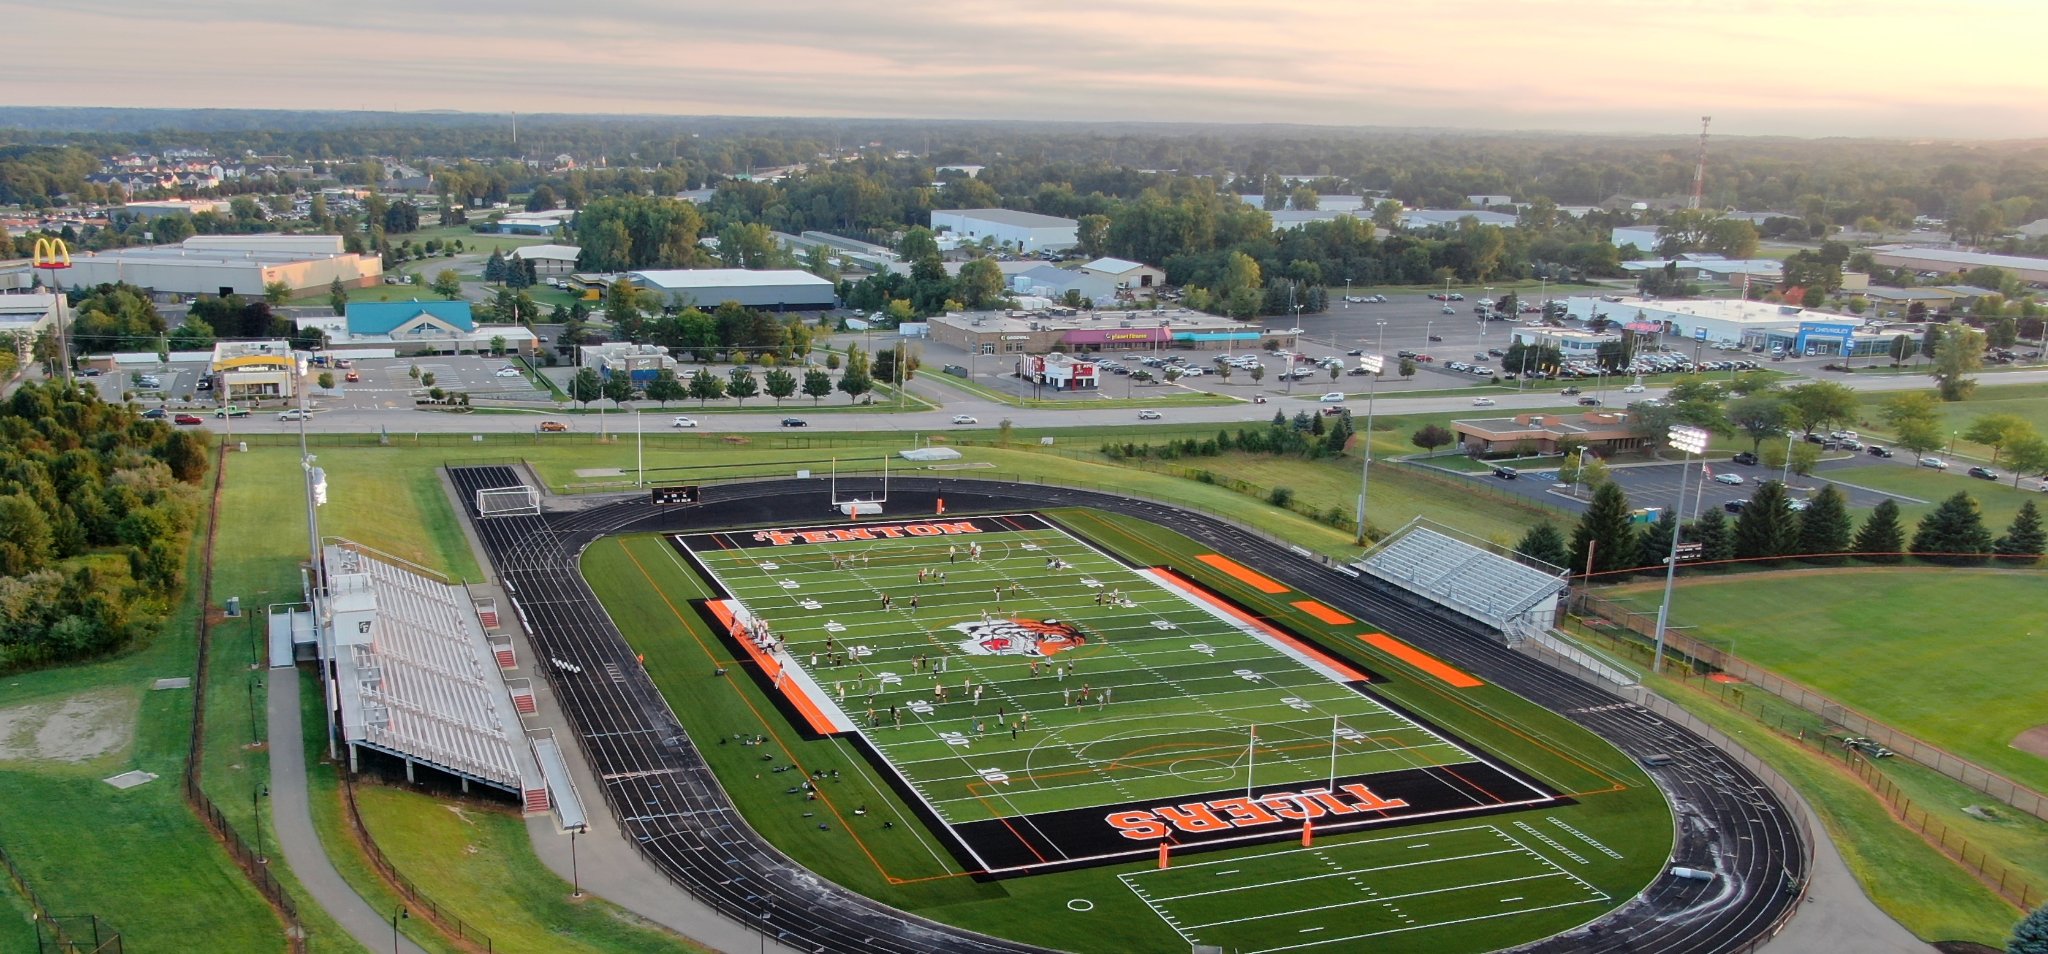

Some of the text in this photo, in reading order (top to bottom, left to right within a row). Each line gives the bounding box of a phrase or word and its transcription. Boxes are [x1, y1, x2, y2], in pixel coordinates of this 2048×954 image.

[766, 521, 983, 545] FENTON
[977, 767, 1009, 782] 10
[1105, 783, 1409, 840] TIGERS
